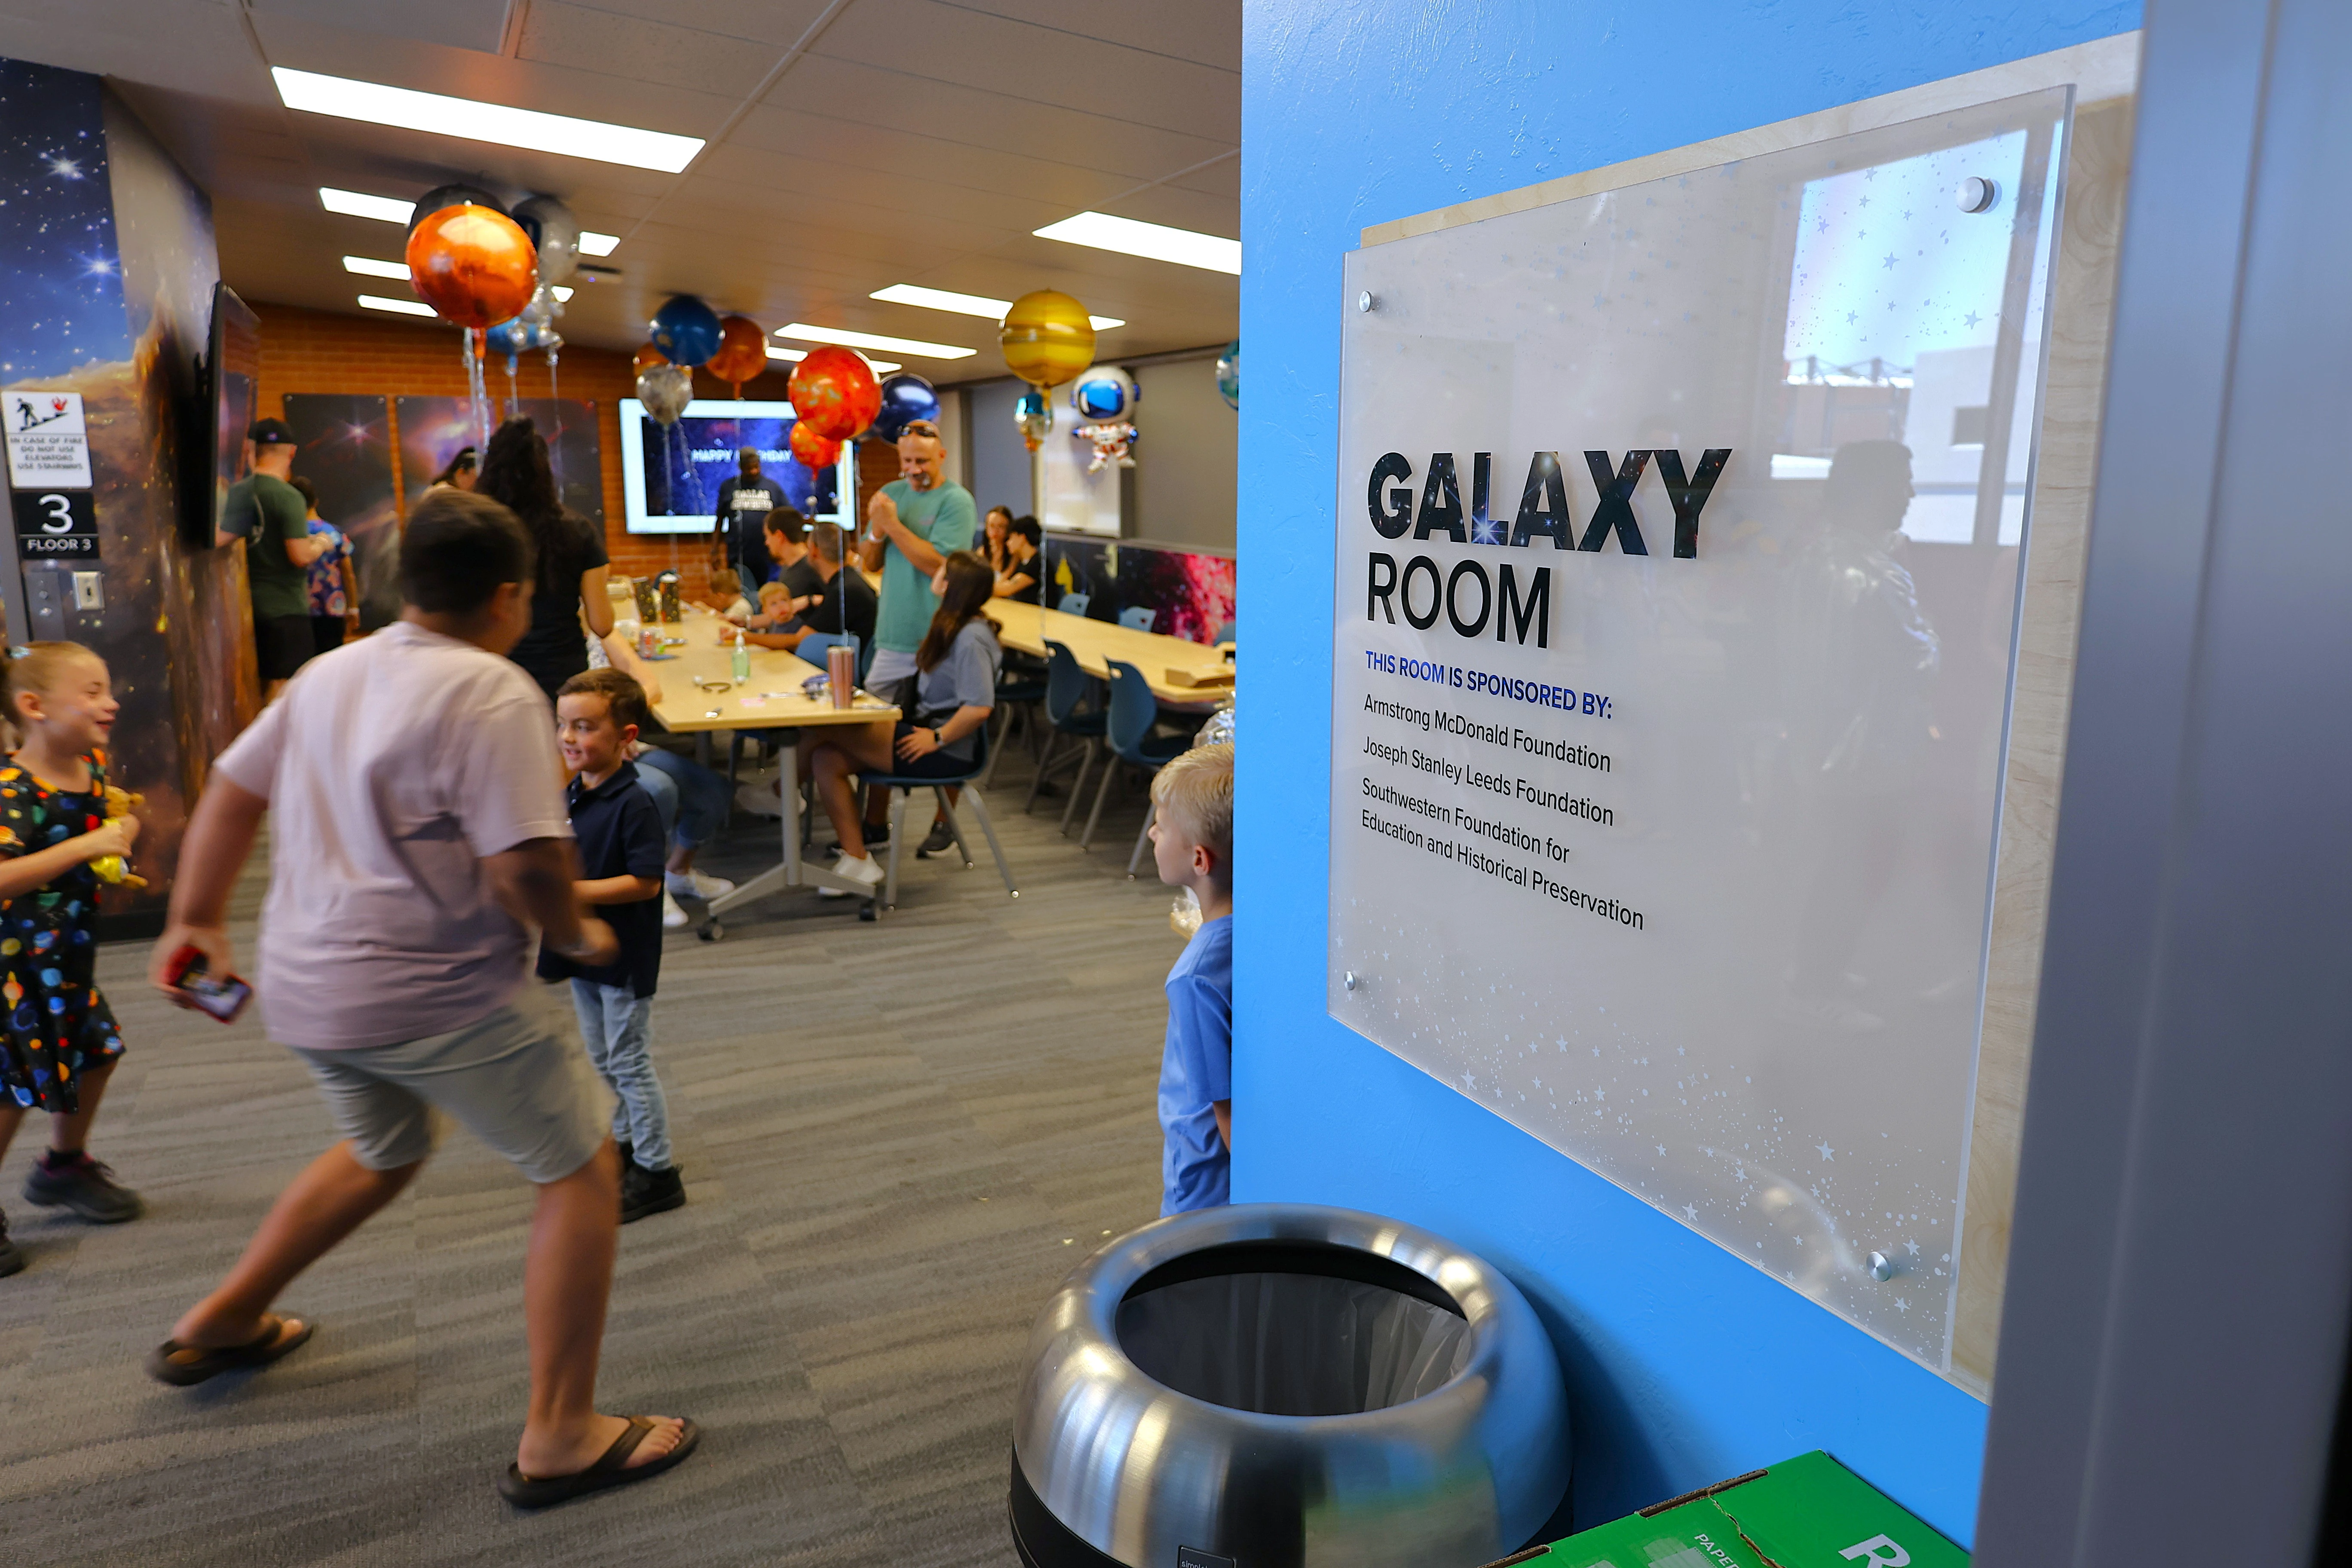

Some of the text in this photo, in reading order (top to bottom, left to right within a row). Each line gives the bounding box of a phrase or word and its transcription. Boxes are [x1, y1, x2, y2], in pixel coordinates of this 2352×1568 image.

[691, 449, 793, 463] HAPPY THDAY
[38, 494, 74, 534] 3
[1368, 449, 1732, 559] GALAXY
[27, 538, 92, 552] FLOOR 3
[1368, 552, 1550, 649] ROOM
[1366, 650, 1612, 719] THIS ROOM IS SPONSORED BY:
[1364, 694, 1611, 772] Armstrong McDonald Foundation
[1363, 736, 1614, 826] Joseph Stanley Leeds Foundation
[1363, 778, 1569, 863] Southwestern Foundation for
[1362, 809, 1643, 930] Education and Historical Preservation
